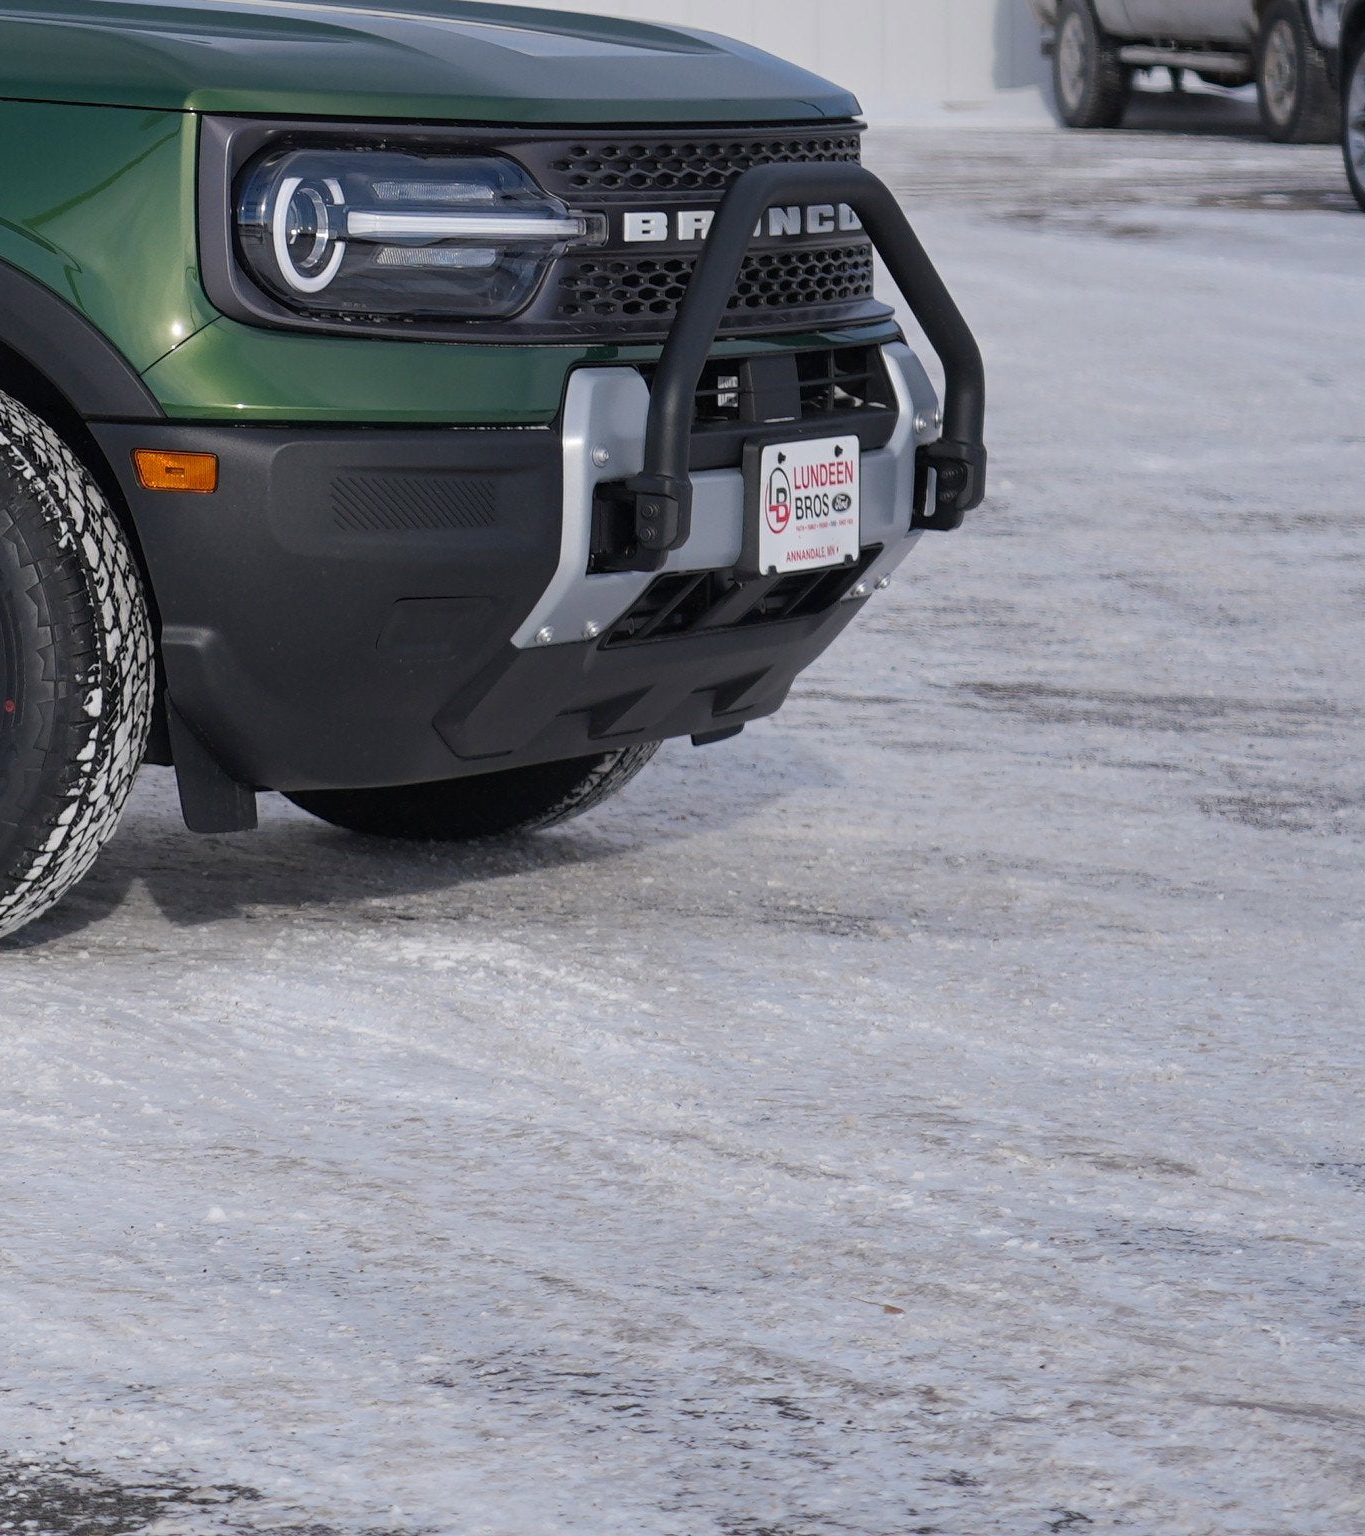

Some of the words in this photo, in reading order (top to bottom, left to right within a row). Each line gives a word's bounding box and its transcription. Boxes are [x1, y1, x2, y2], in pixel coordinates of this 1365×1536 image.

[623, 202, 863, 242] BRNCO
[793, 460, 853, 490] LUNDEEN
[795, 492, 829, 520] BROS
